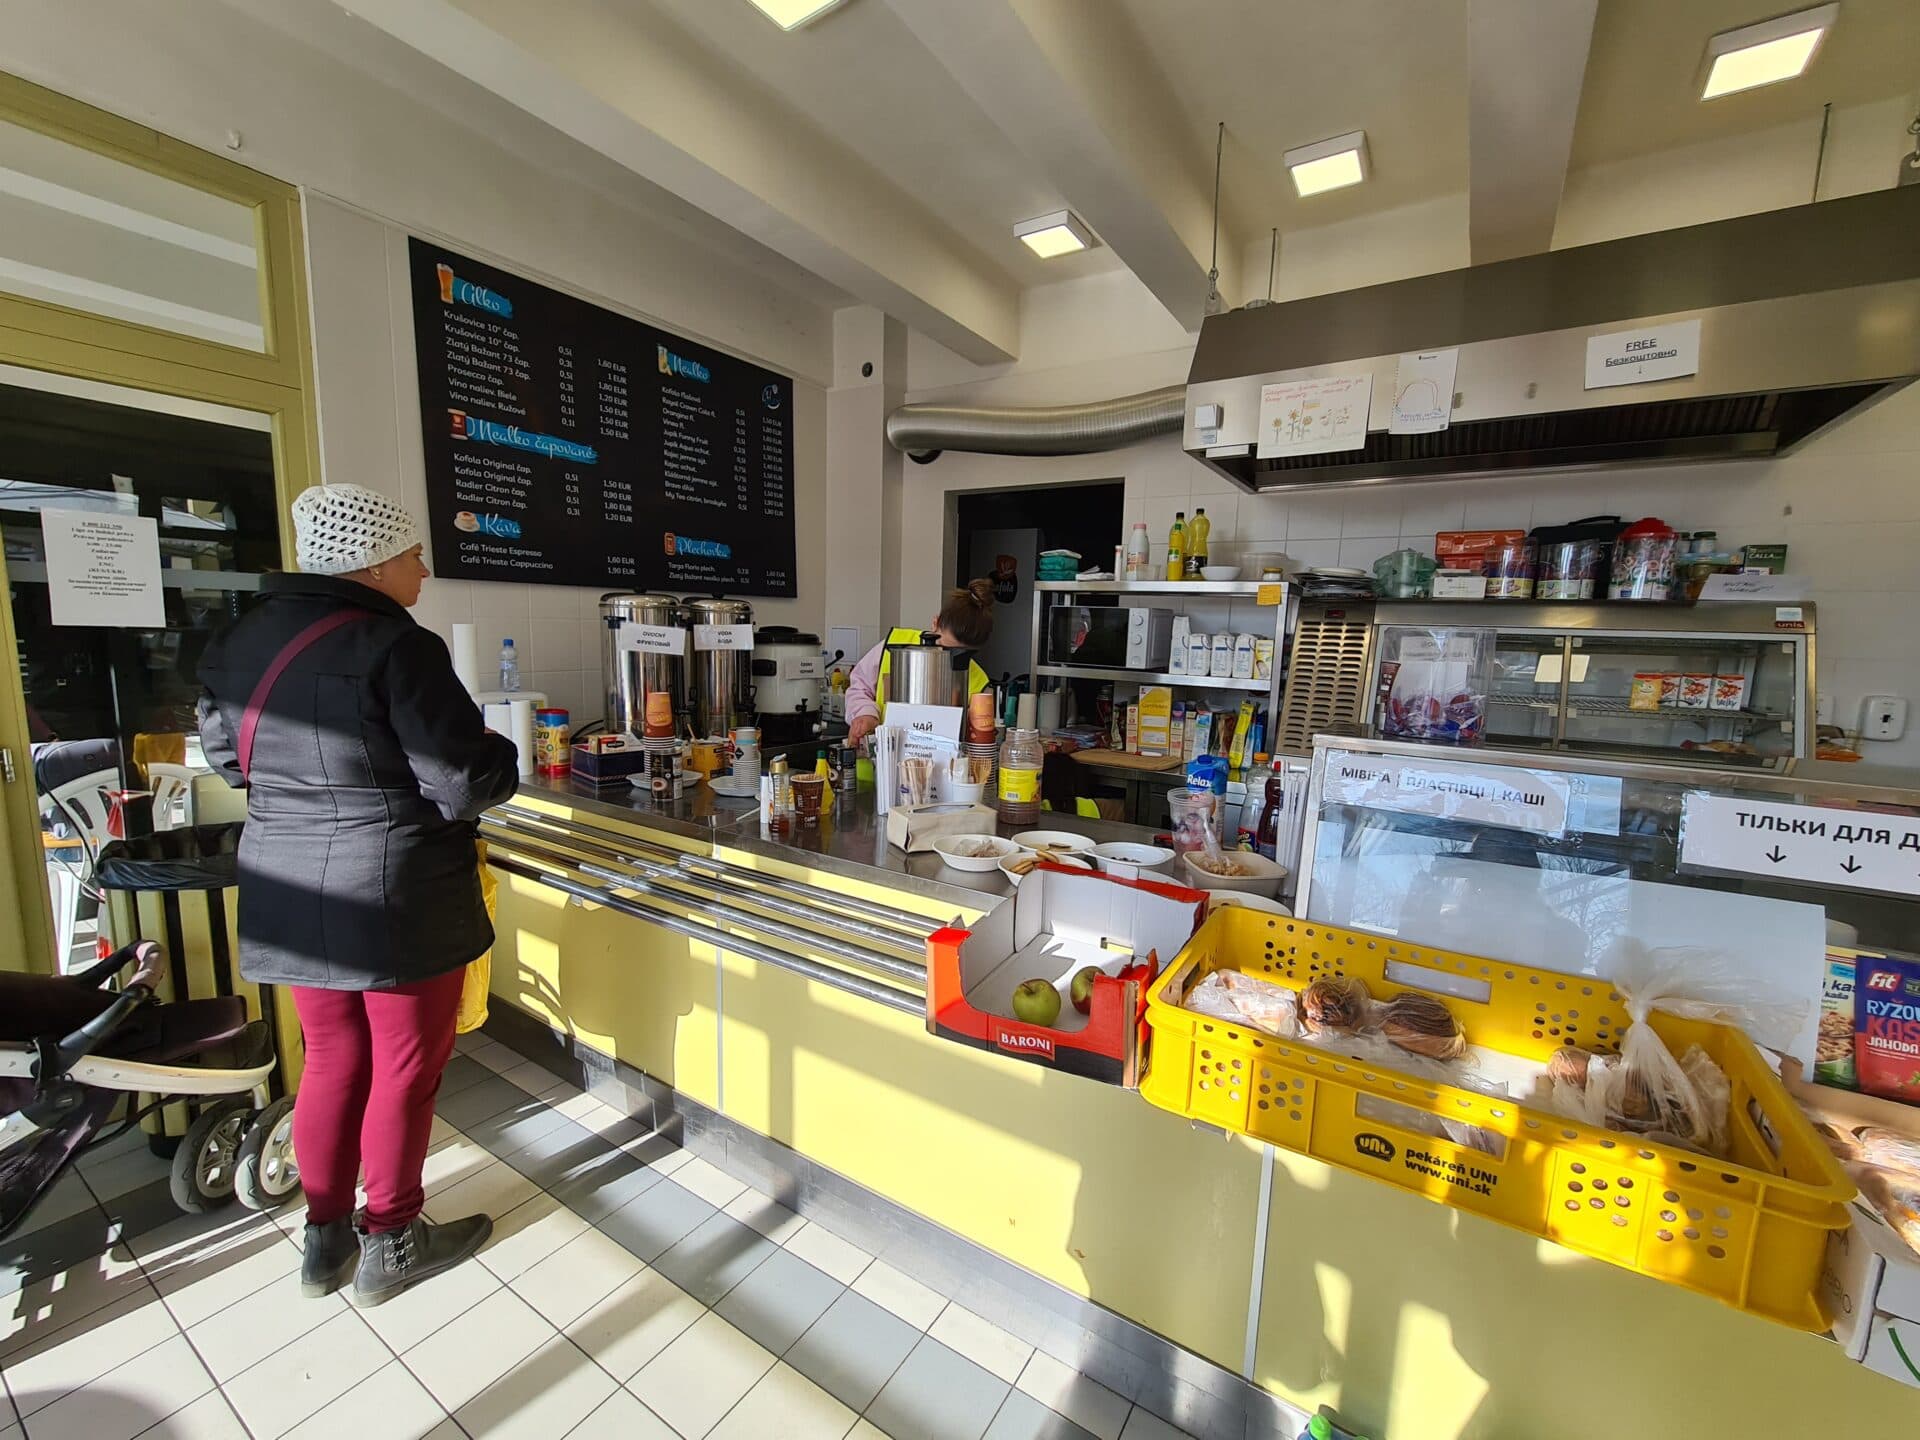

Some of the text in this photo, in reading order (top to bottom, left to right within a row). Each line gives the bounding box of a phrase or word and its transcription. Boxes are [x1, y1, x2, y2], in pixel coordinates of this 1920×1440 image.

[443, 309, 486, 330] Krušovice
[502, 328, 520, 340] čap.
[613, 363, 627, 374] EUR
[444, 323, 487, 344] Krušovice
[503, 341, 521, 353] čap.
[613, 375, 627, 385] EUR
[1625, 338, 1657, 352] FREE
[446, 337, 470, 352] Zlatý
[471, 344, 500, 359] Bažant
[502, 353, 513, 363] 73
[514, 357, 531, 369] čap.
[614, 386, 627, 396] EUR
[673, 354, 709, 378] Nealko
[1605, 349, 1677, 367] Безкоштовно
[447, 350, 470, 365] Zlatý
[472, 357, 501, 372] Bažant
[503, 365, 514, 376] 73
[515, 370, 532, 381] čap.
[614, 397, 628, 407] EUR
[448, 363, 486, 381] Prosecco
[487, 375, 505, 386] čap.
[614, 408, 628, 418] EUR
[614, 419, 628, 429] EUR
[662, 408, 689, 420] Orangina
[480, 419, 593, 459] Nealko čapované
[615, 430, 629, 441] EUR
[453, 453, 481, 465] Kofola
[482, 458, 515, 471] Original
[516, 465, 532, 474] čap.
[618, 482, 632, 491] EUR
[454, 466, 482, 477] Kofola
[483, 471, 516, 483] Original
[517, 477, 533, 486] čap.
[618, 493, 632, 502] EUR
[455, 479, 483, 490] Radler
[485, 483, 510, 494] Citron
[511, 488, 528, 498] čap.
[619, 504, 632, 513] EUR
[456, 491, 484, 503] Radler
[486, 495, 511, 506] Citron
[512, 500, 528, 509] čap.
[619, 515, 633, 524] EUR
[665, 491, 675, 500] My
[485, 512, 522, 538] Káva
[481, 544, 508, 554] Trieste
[509, 546, 543, 557] Espresso
[621, 557, 635, 565] EUR
[680, 538, 727, 558] Plechovka
[482, 557, 509, 567] Trieste
[510, 559, 554, 569] Cappuccino
[622, 568, 636, 576] EUR
[912, 720, 933, 732] ЧАЙ
[1187, 774, 1212, 788] Relax
[1406, 776, 1486, 798] ПЛАСТІВЦІ
[1502, 789, 1545, 806] КАШІ
[1736, 811, 1826, 837] ТІЛЬКИ
[1832, 824, 1892, 845] ДЛЯ
[1000, 1032, 1051, 1051] BARONI
[1866, 1036, 1919, 1054] JAHODA
[1405, 1159, 1492, 1197] www.uni.sk
[1406, 1149, 1498, 1186] pekáreň UNI
